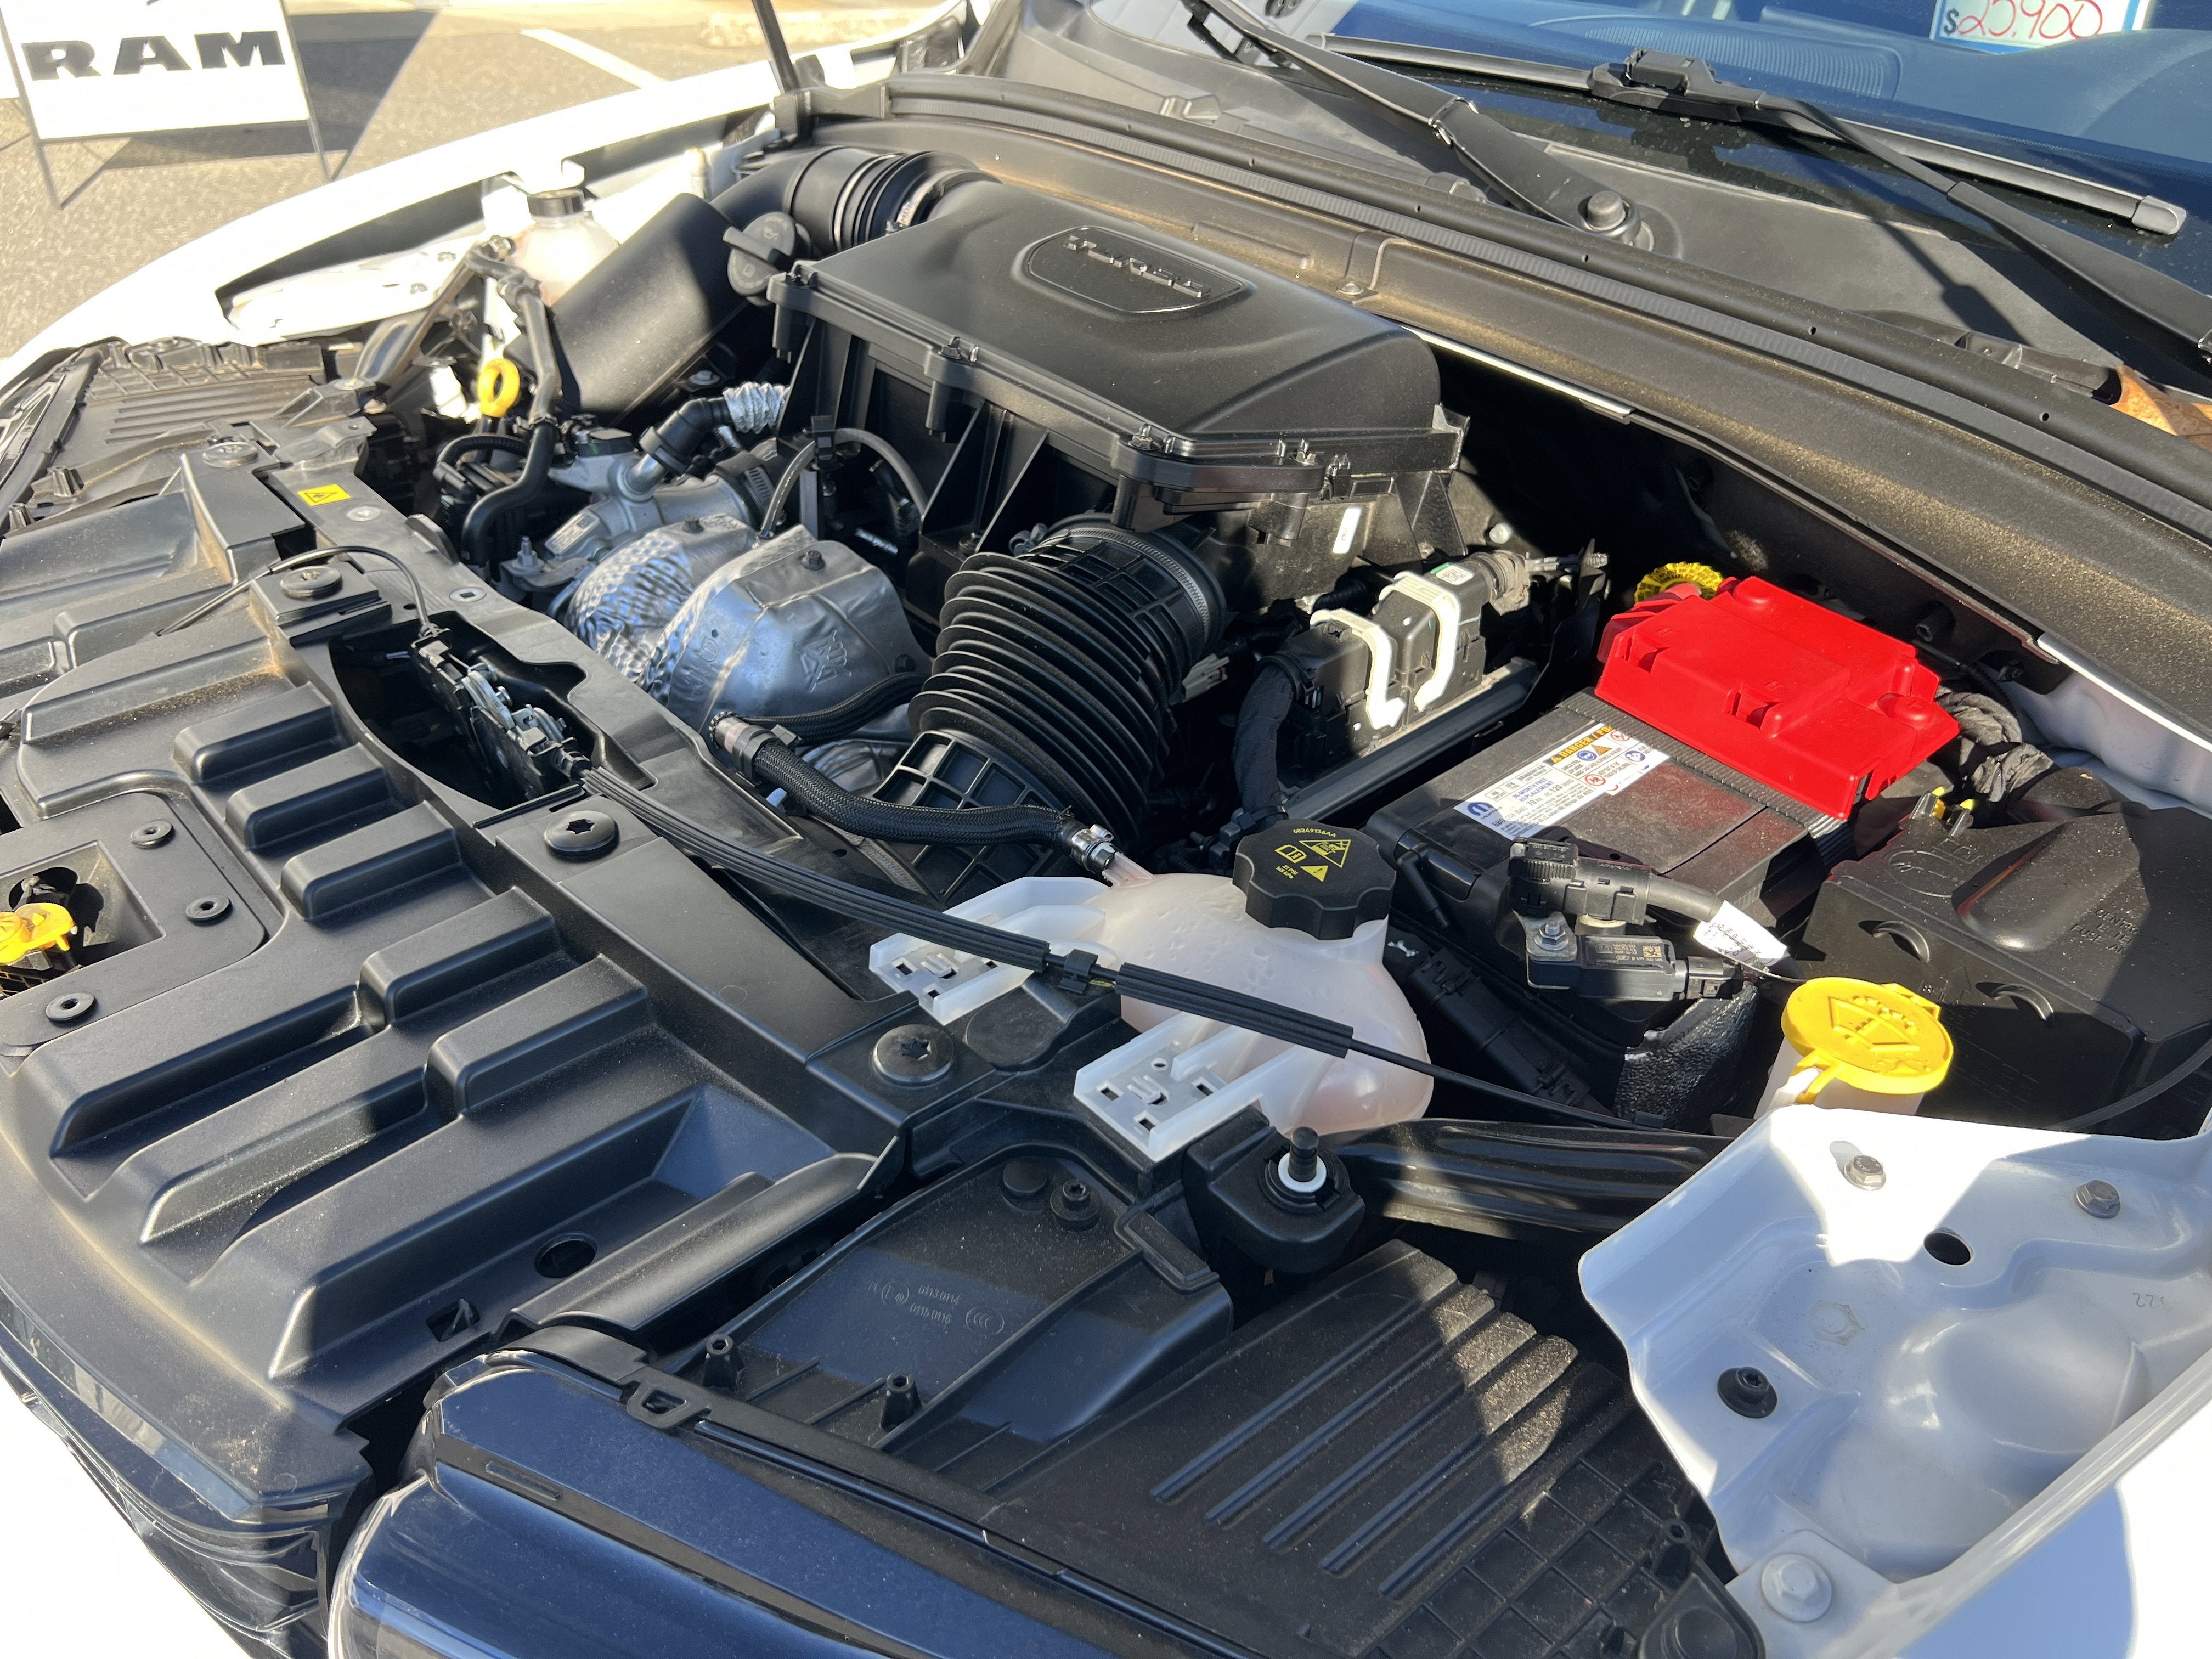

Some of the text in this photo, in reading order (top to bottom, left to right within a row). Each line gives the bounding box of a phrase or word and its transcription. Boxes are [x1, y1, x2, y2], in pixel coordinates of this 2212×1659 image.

[21, 31, 286, 81] RAM
[1558, 737, 1594, 757] DANGER
[1517, 781, 1555, 802] REPLACEMENT
[1491, 818, 1506, 827] 680
[2070, 923, 2106, 945] FUSE
